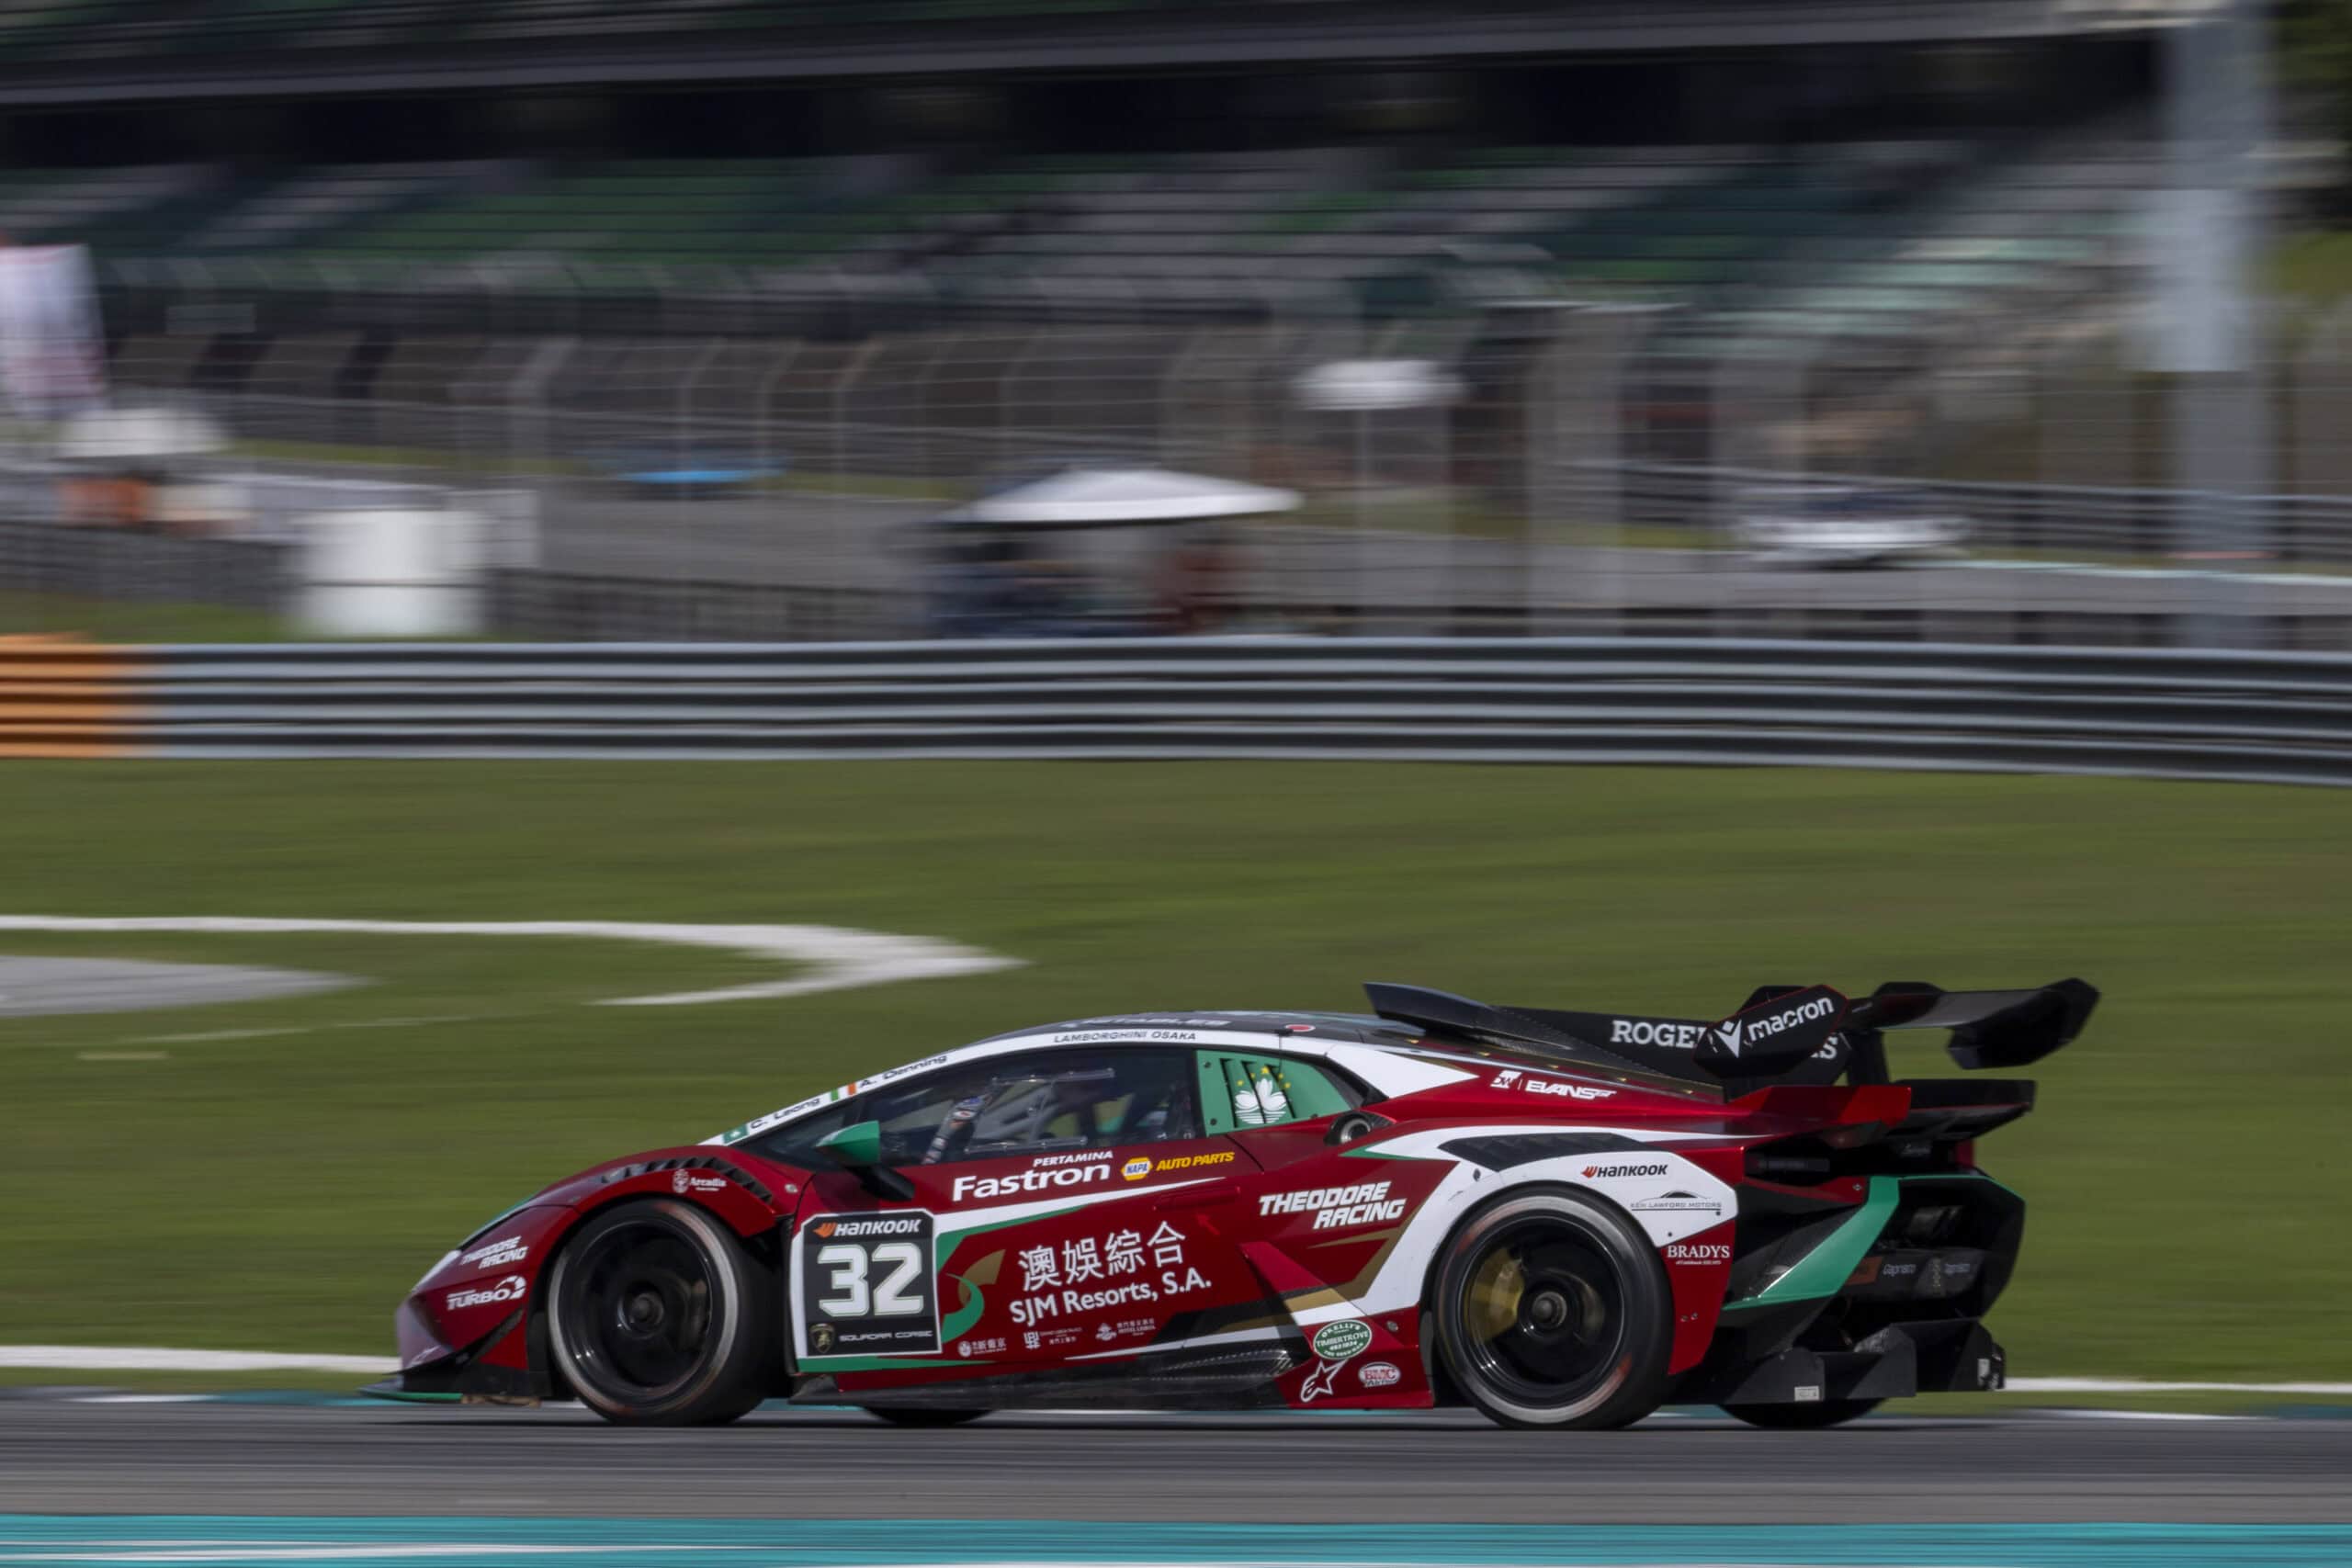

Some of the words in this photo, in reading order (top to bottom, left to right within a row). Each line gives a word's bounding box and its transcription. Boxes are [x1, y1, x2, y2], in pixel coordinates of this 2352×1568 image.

[1611, 1020, 1707, 1049] ROGE
[1747, 997, 1835, 1042] macron
[1054, 1030, 1148, 1043] LAMBORGHINI
[1151, 1030, 1197, 1041] OSAKA
[859, 1078, 877, 1089] A.
[882, 1055, 948, 1080] Denning
[773, 1097, 820, 1121] Leong
[1033, 1150, 1114, 1168] PERTAMINA
[1125, 1160, 1148, 1177] NAPA
[1156, 1157, 1192, 1172] AUTO
[1193, 1151, 1236, 1167] PARTS
[952, 1163, 1111, 1202] Fastron
[1259, 1180, 1392, 1217] THEODORE
[1313, 1198, 1408, 1230] RACING
[1017, 1220, 1186, 1292] 澳娛綜合
[1667, 1245, 1731, 1259] BRADYS
[817, 1242, 924, 1317] 32
[1009, 1293, 1058, 1326] SJM
[1062, 1281, 1159, 1314] Resorts,
[1161, 1267, 1213, 1295] S.A.
